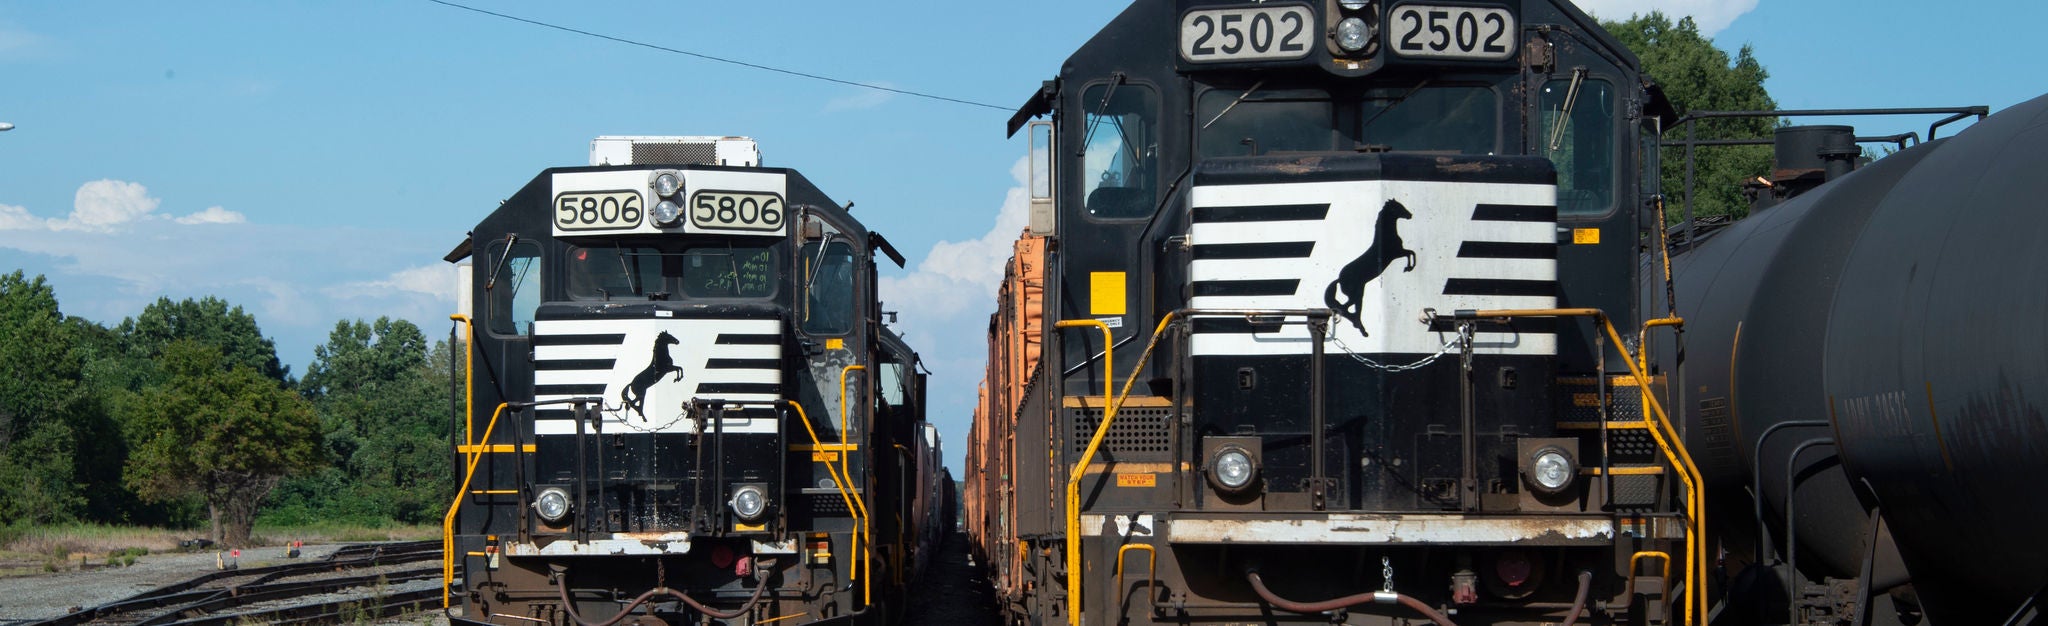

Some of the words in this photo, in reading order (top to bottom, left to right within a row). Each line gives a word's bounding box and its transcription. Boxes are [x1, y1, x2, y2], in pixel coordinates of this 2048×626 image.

[1191, 10, 1304, 56] 2502
[1400, 9, 1506, 53] 2502
[560, 195, 641, 224] 5806
[696, 195, 781, 225] 5806
